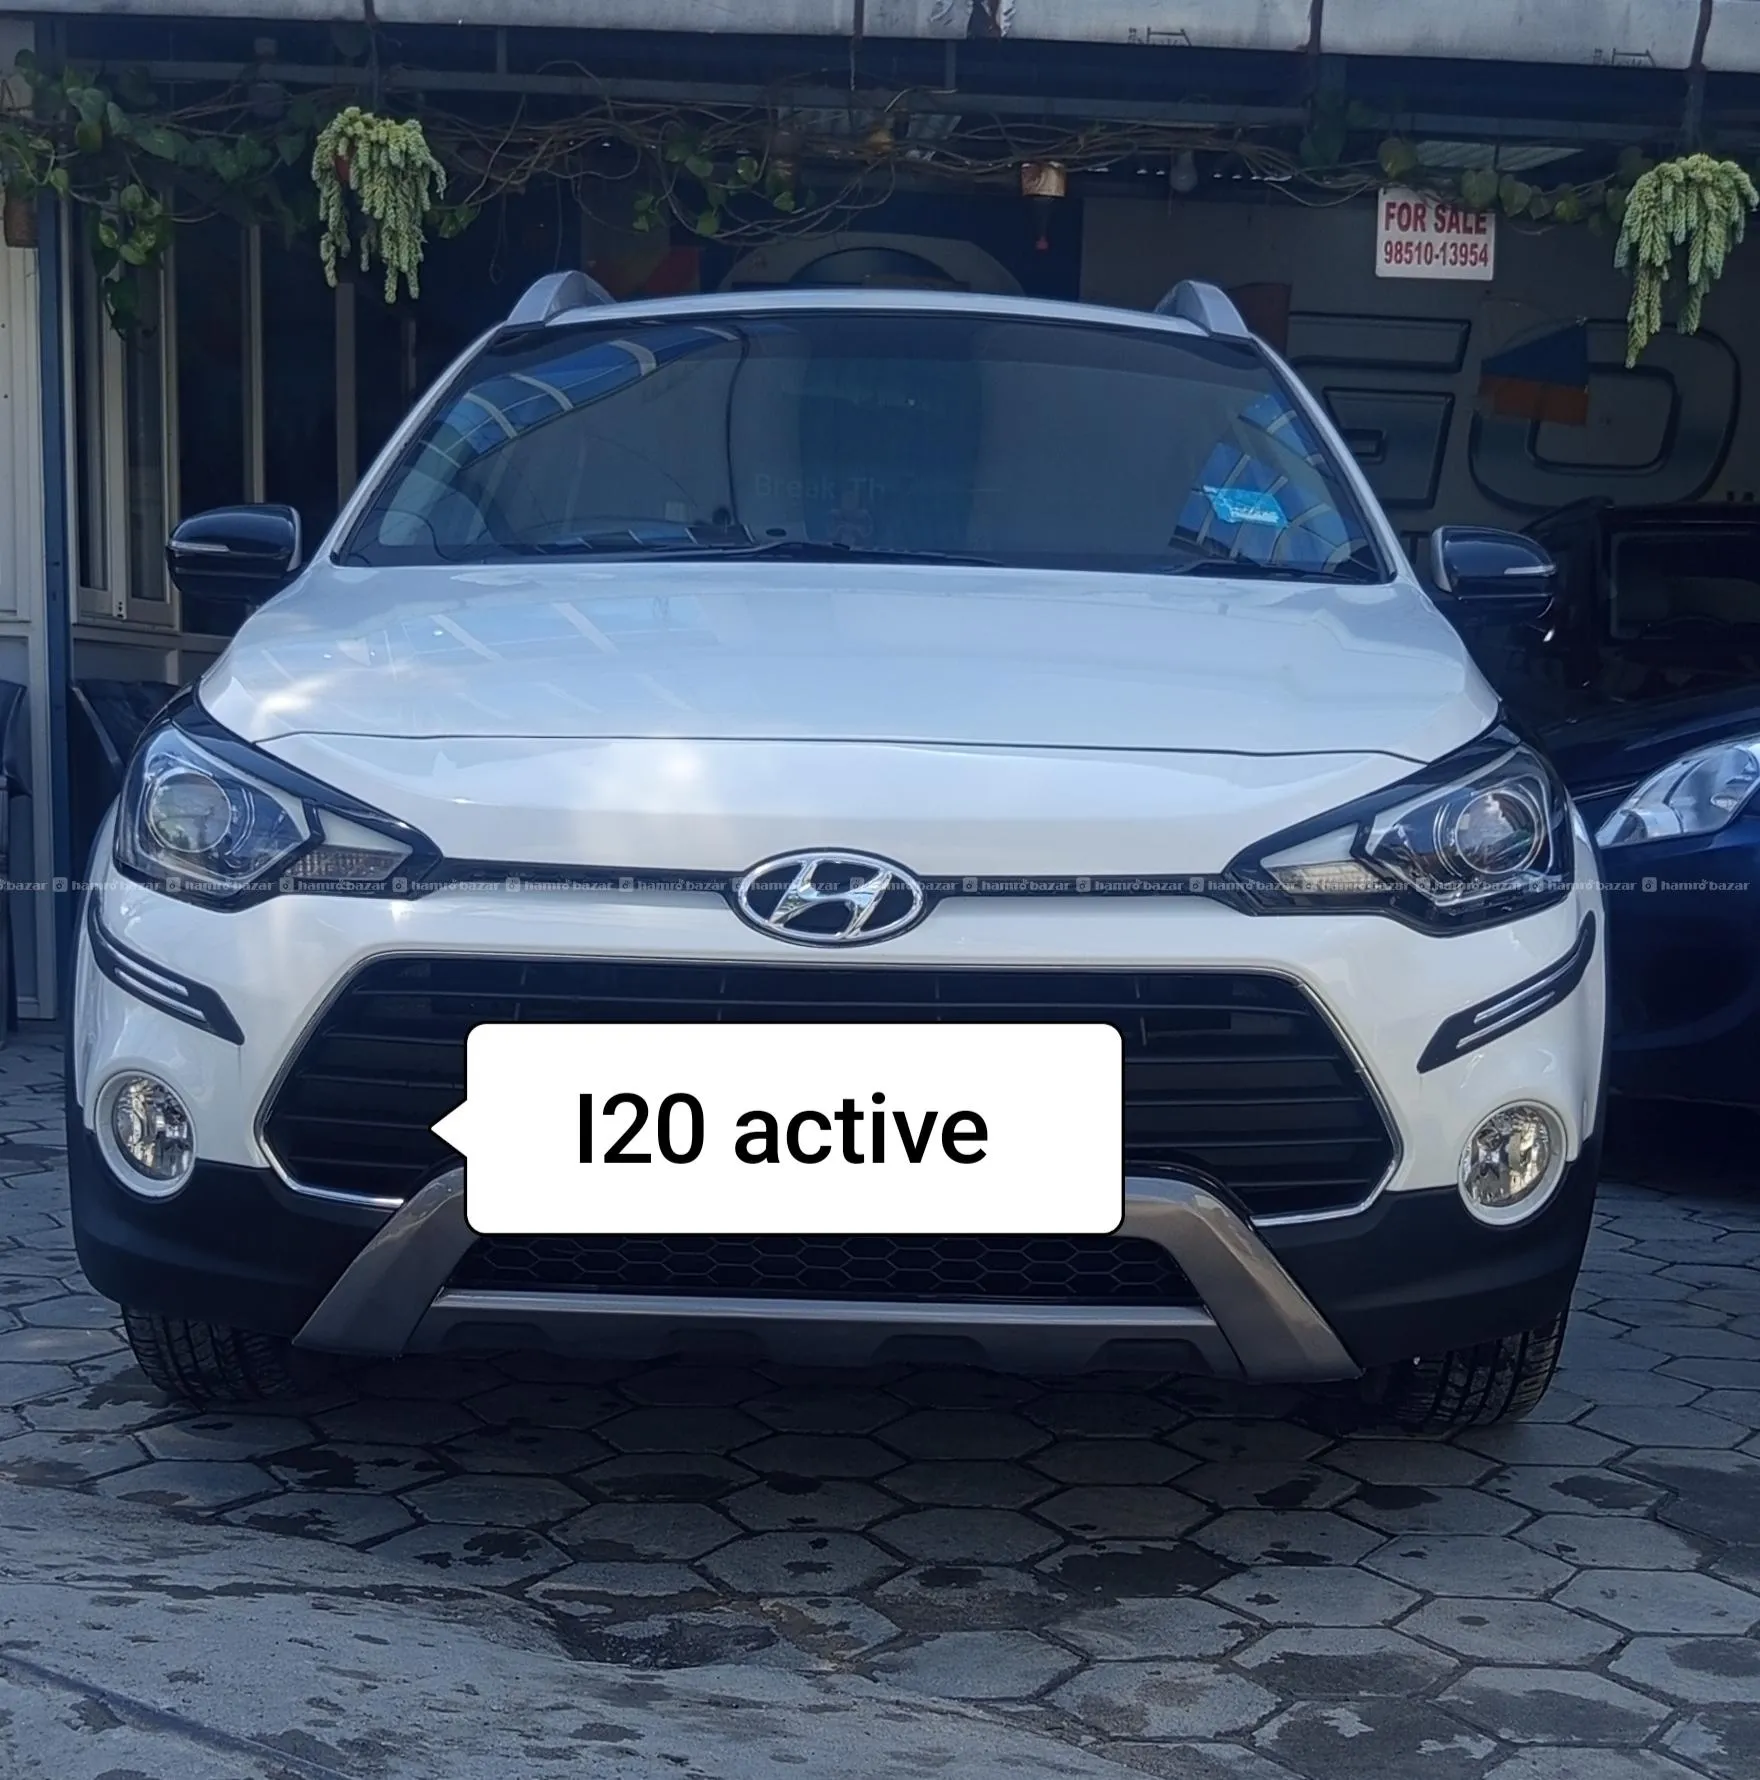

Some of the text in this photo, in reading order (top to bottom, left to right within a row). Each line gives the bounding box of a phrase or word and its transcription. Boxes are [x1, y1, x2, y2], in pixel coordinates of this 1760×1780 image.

[1384, 201, 1488, 235] FOR SALE
[1384, 240, 1489, 268] 98510-13954
